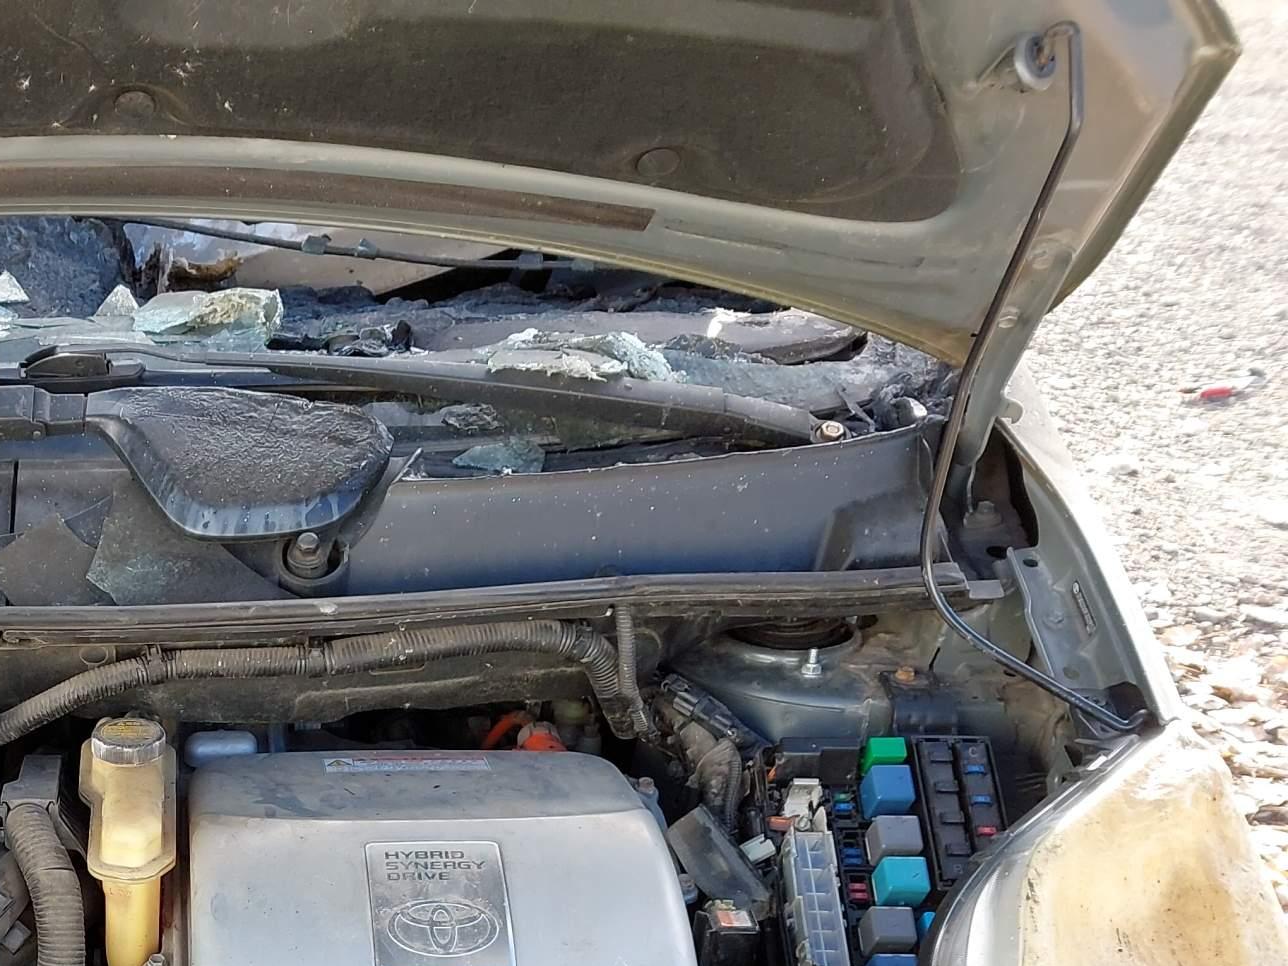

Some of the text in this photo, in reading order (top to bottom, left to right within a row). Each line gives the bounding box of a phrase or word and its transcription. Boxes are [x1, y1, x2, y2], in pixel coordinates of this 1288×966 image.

[384, 850, 465, 860] HYBRID
[385, 860, 486, 871] SYNERGY
[387, 871, 450, 881] DRIVE
